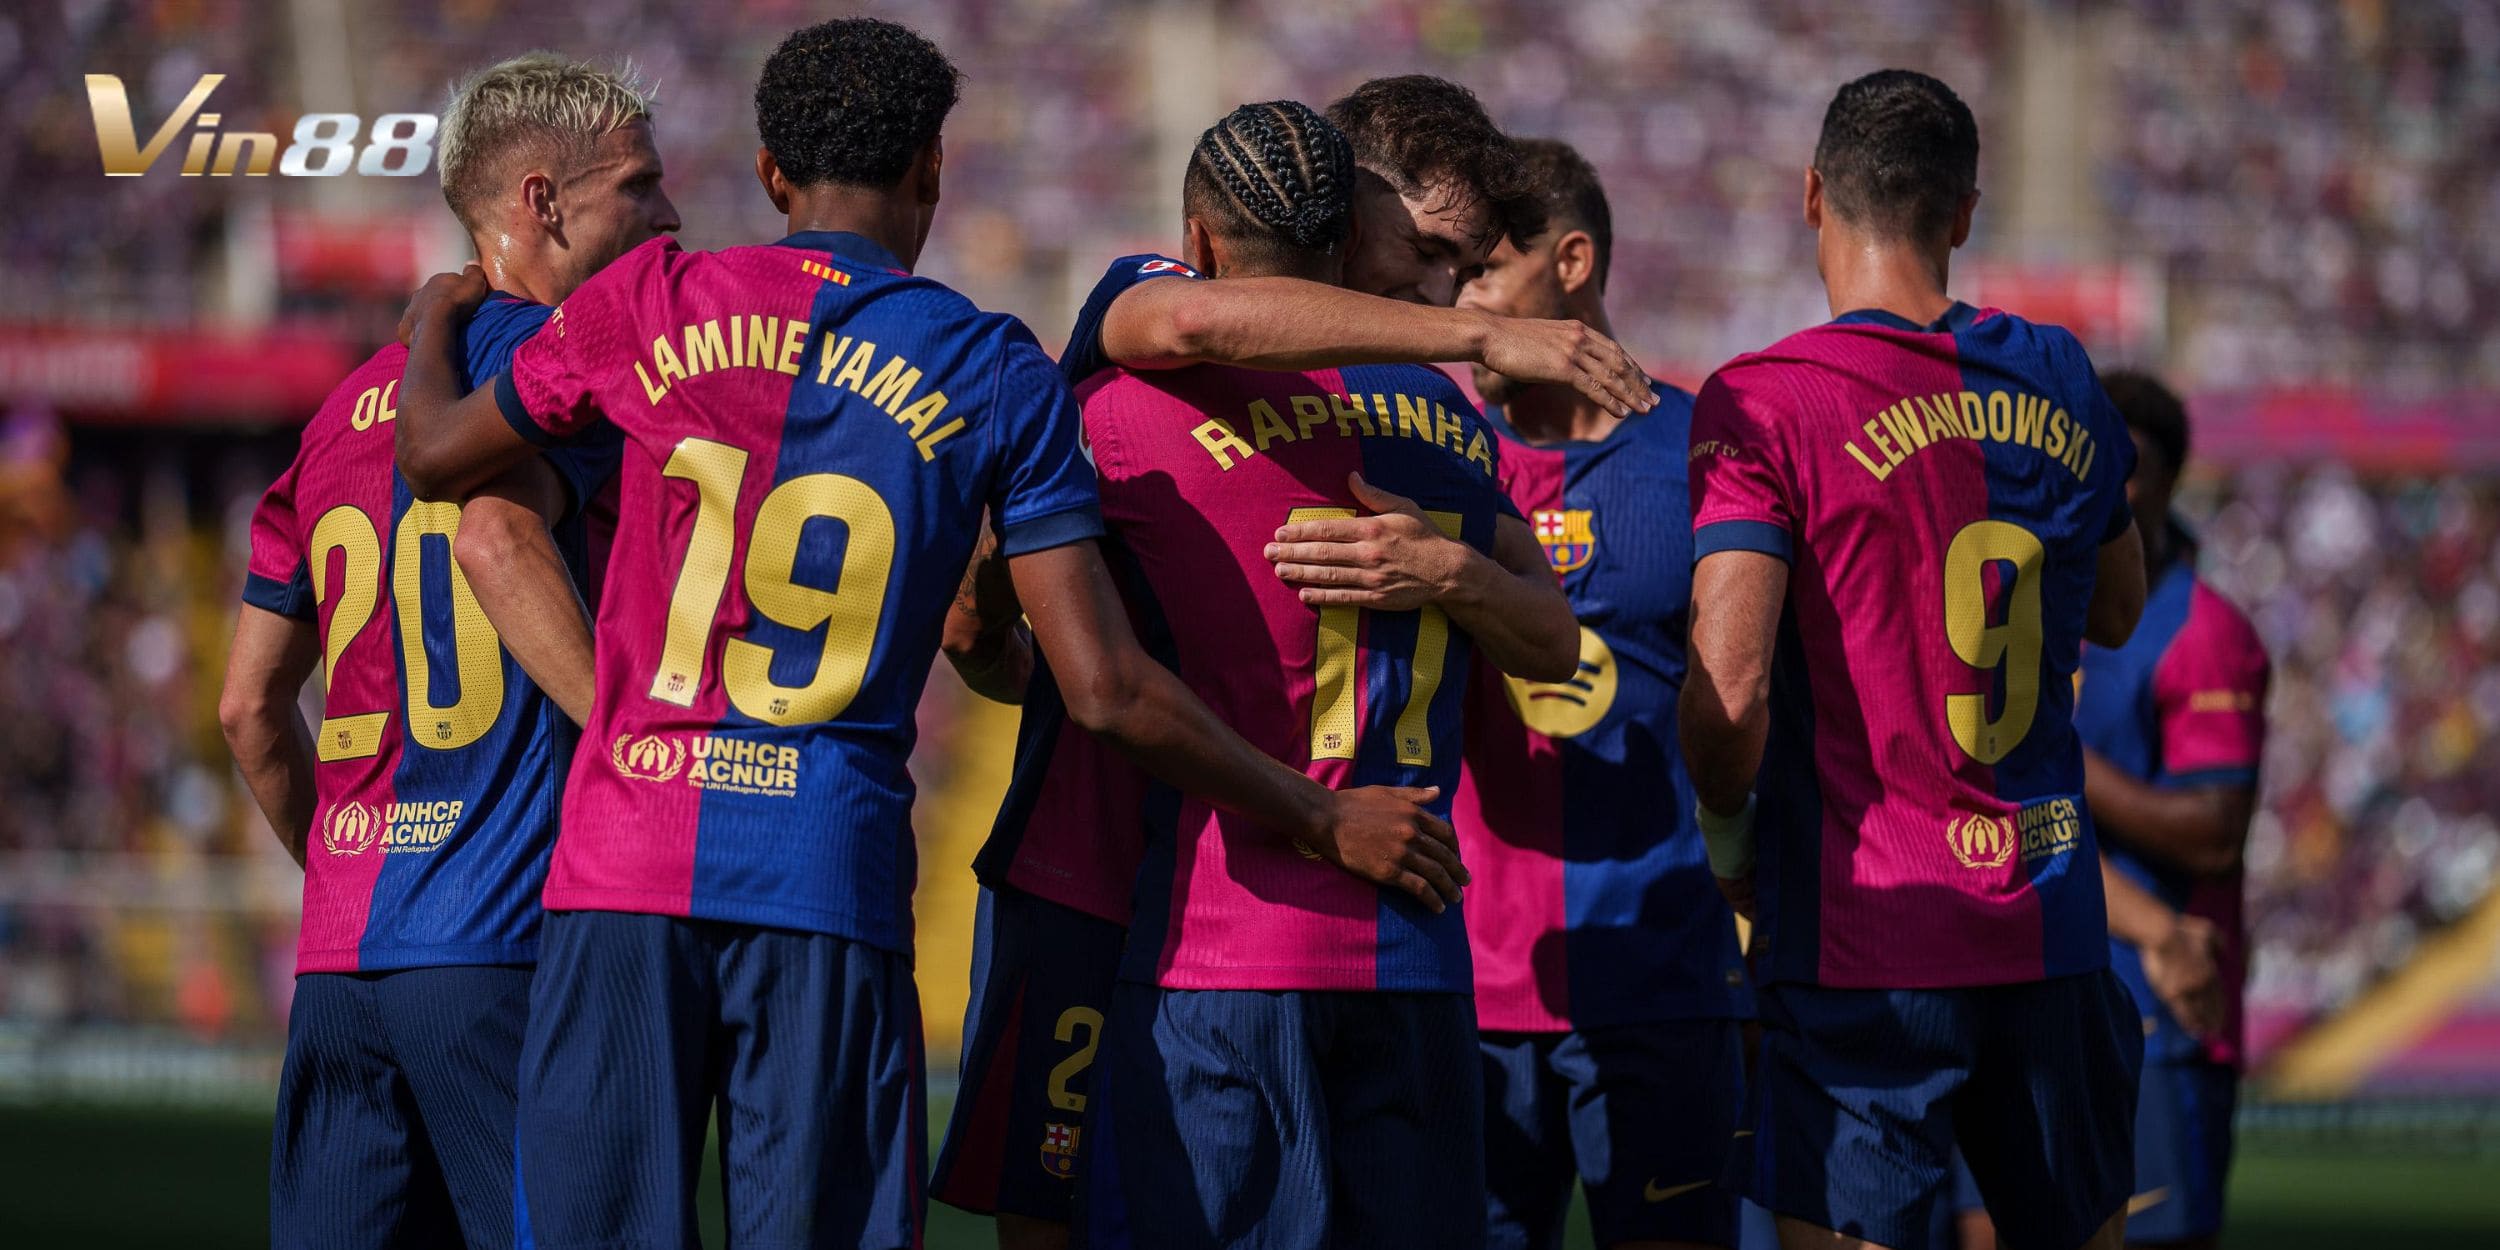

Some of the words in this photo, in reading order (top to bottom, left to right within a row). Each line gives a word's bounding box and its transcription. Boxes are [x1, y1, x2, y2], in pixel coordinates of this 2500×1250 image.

[633, 315, 810, 406] LAMINE
[816, 331, 966, 462] YAMAL
[1190, 392, 1496, 475] RAPHINHA
[1844, 390, 2096, 482] LEWANDOWSKI
[648, 437, 896, 727] 19
[310, 497, 504, 763] 20
[1944, 520, 2045, 766] 9
[687, 759, 797, 788] ACNUR
[692, 737, 799, 770] UNHCR
[385, 801, 463, 823] UNHCR
[688, 779, 705, 789] The
[706, 781, 721, 790] UN
[722, 784, 760, 794] Refugee
[761, 788, 796, 798] Agency
[2016, 798, 2078, 832] UNHCR
[379, 821, 456, 845] ACNUR
[2020, 818, 2080, 853] ACNUR
[1047, 1006, 1104, 1112] 2
